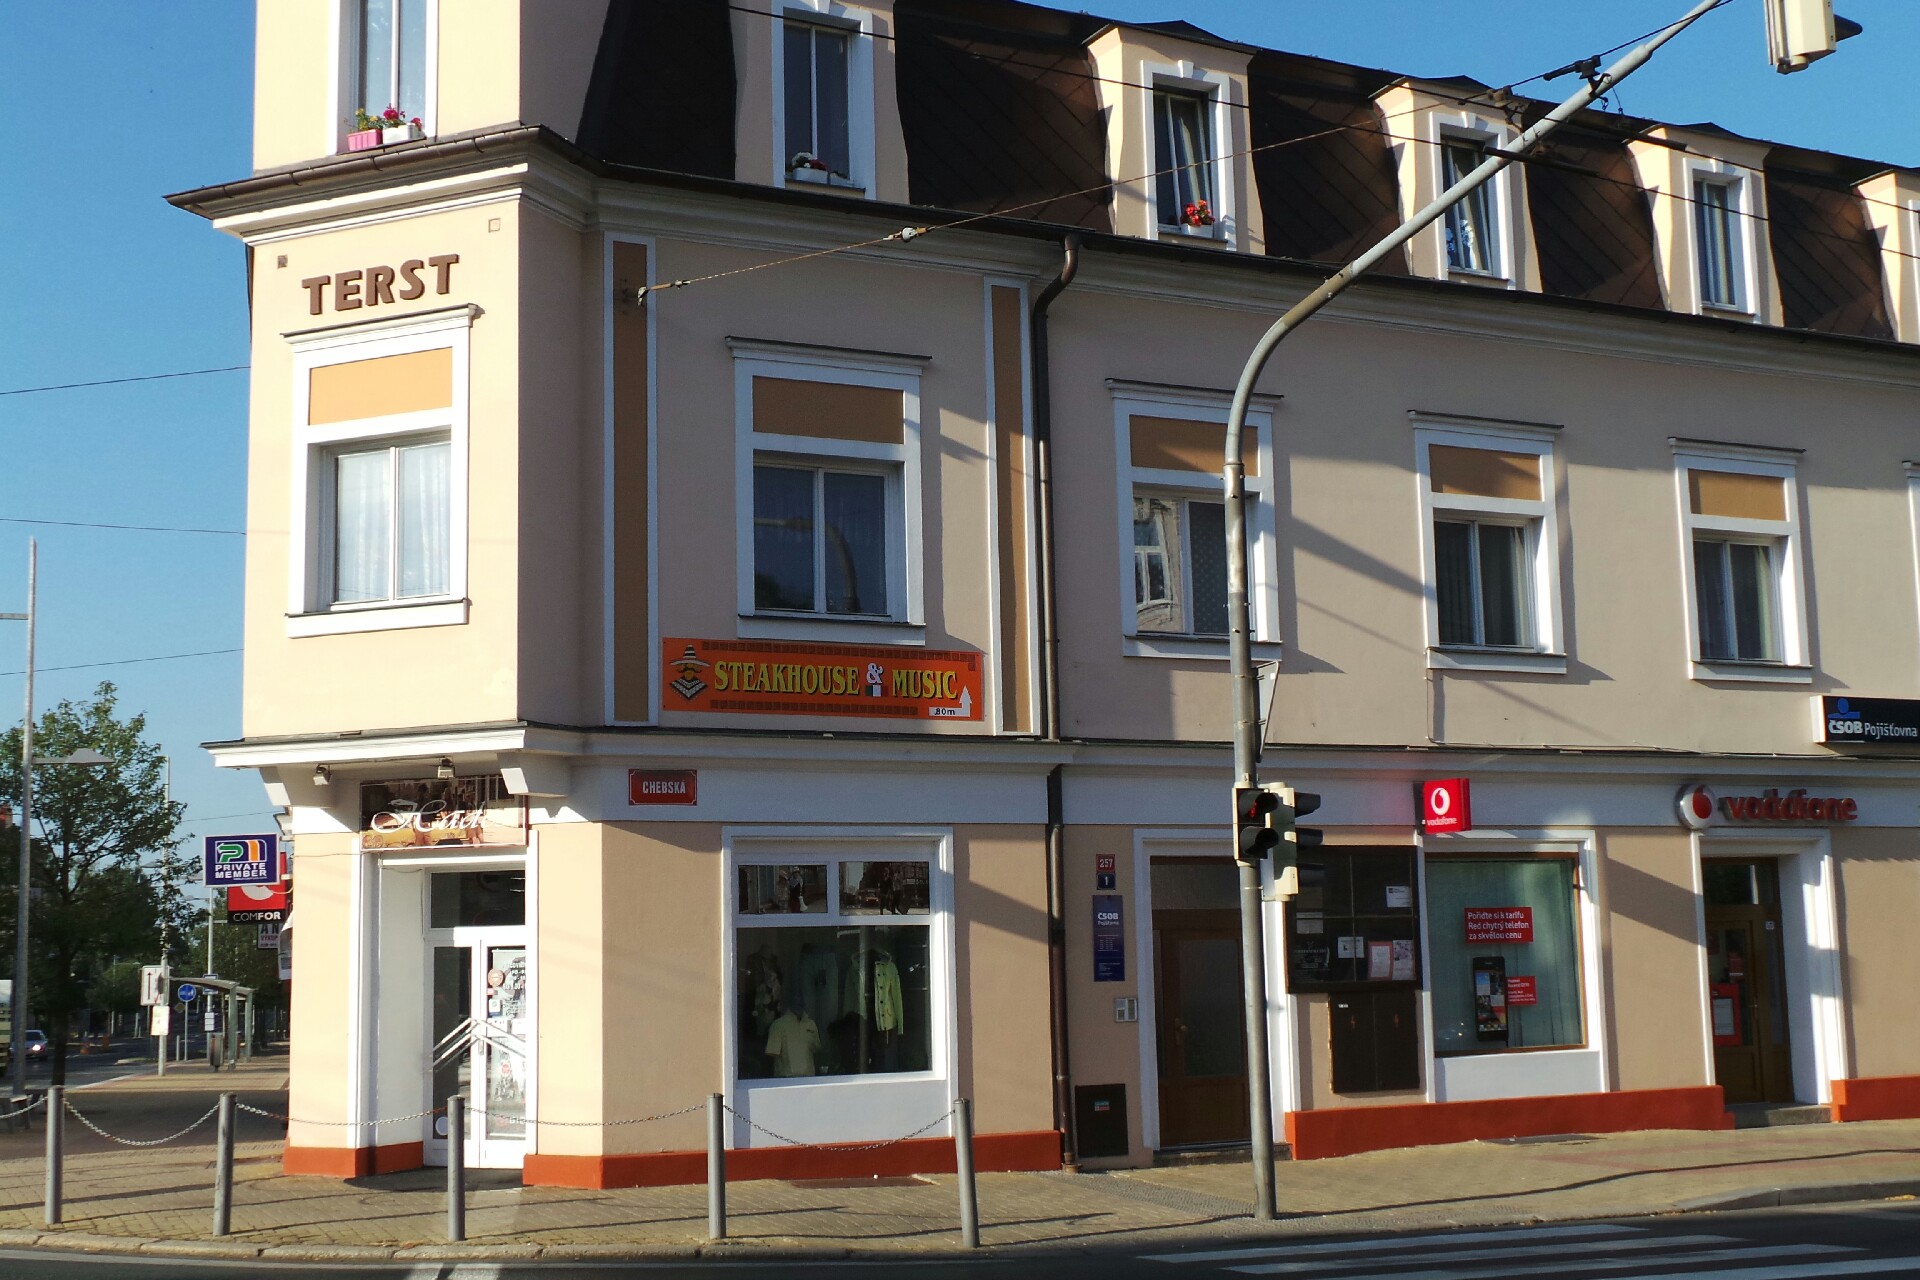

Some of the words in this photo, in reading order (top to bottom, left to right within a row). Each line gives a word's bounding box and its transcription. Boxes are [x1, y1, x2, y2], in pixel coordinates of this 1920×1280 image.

[301, 253, 460, 316] TERST
[714, 660, 860, 696] STEAKHOUSE
[866, 662, 884, 684] &
[892, 669, 959, 699] MUSIC
[1828, 719, 1863, 734] ČSOB
[1864, 722, 1918, 740] Pojišťovna
[1725, 788, 1858, 821] vodafone
[215, 863, 266, 872] PRIVATE
[1099, 858, 1114, 868] 257
[215, 870, 267, 879] MEMBER
[1104, 876, 1109, 886] 1
[233, 911, 281, 921] COMFOR
[1505, 911, 1524, 919] tarifu
[1468, 922, 1481, 930] Red
[1482, 921, 1504, 931] chytrý
[1505, 921, 1529, 929] telefon
